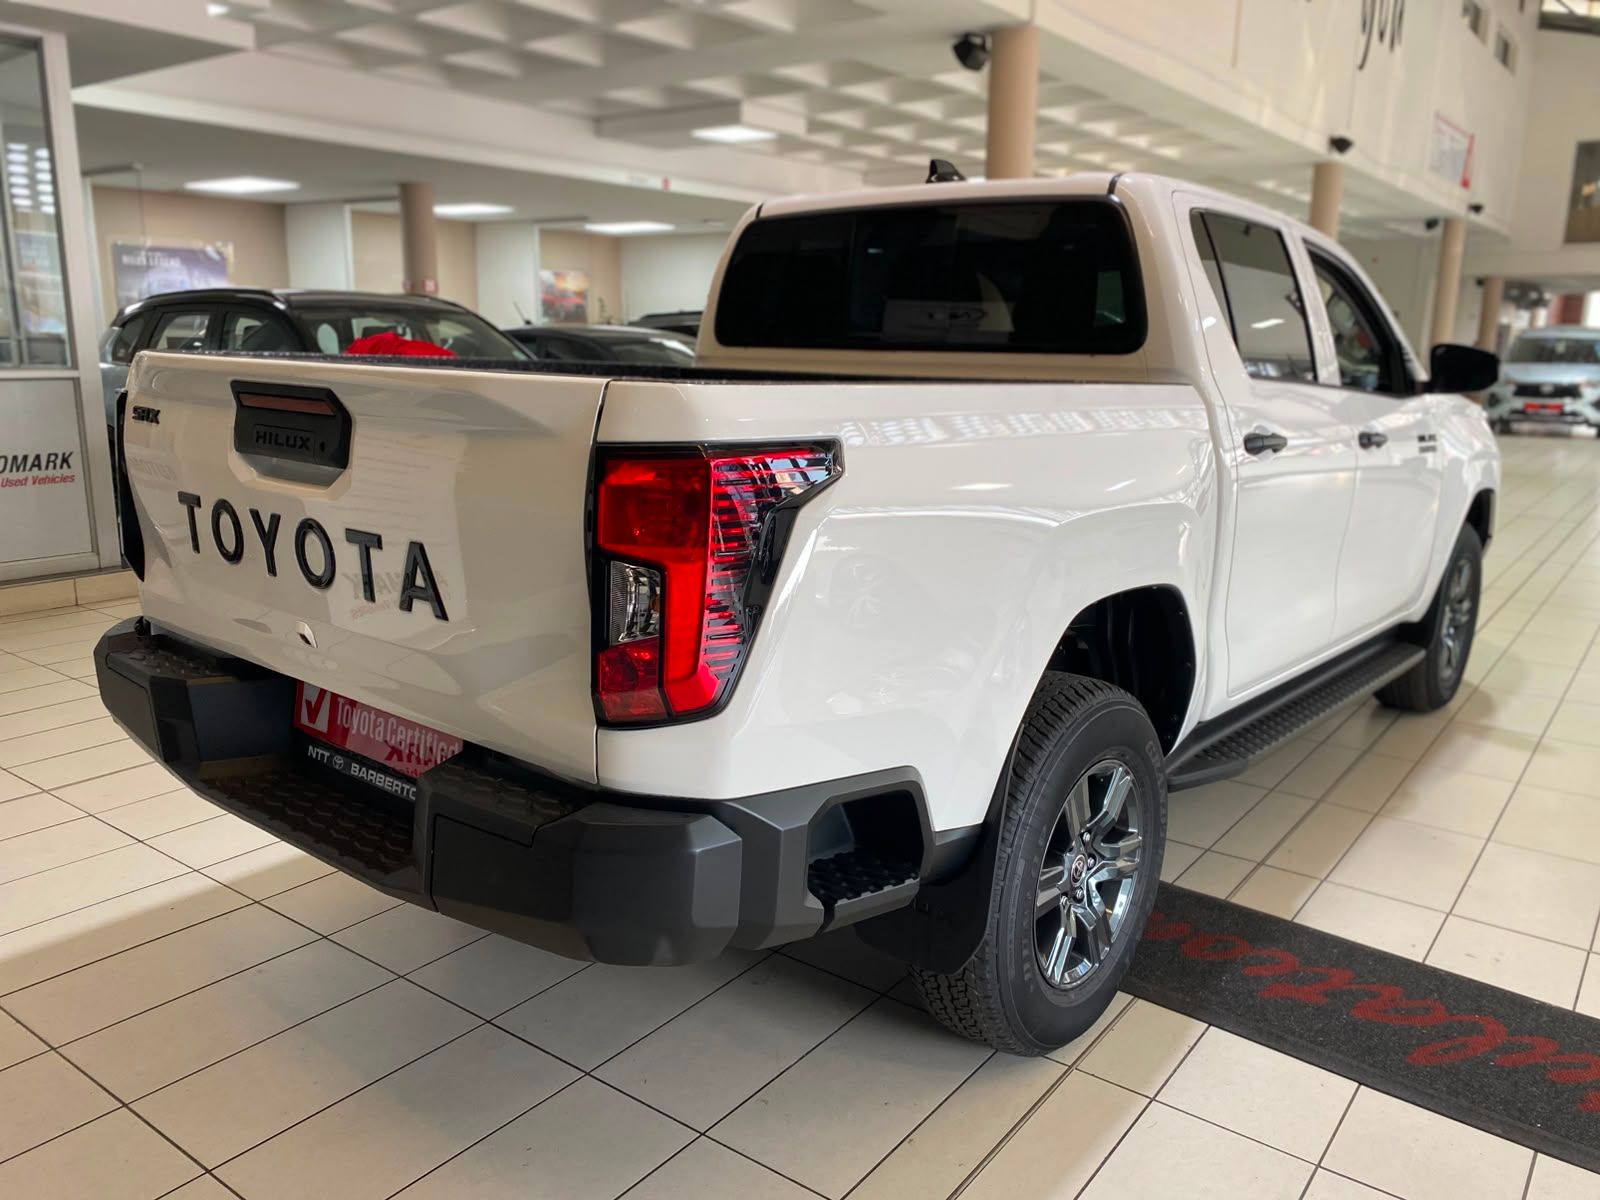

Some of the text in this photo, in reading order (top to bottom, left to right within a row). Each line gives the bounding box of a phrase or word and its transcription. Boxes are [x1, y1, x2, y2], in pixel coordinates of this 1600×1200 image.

[255, 430, 311, 452] HILUX
[0, 473, 75, 488] Used Vehicles
[177, 490, 449, 622] TOYOTA
[336, 696, 385, 742] Toyota
[307, 745, 330, 763] NTT
